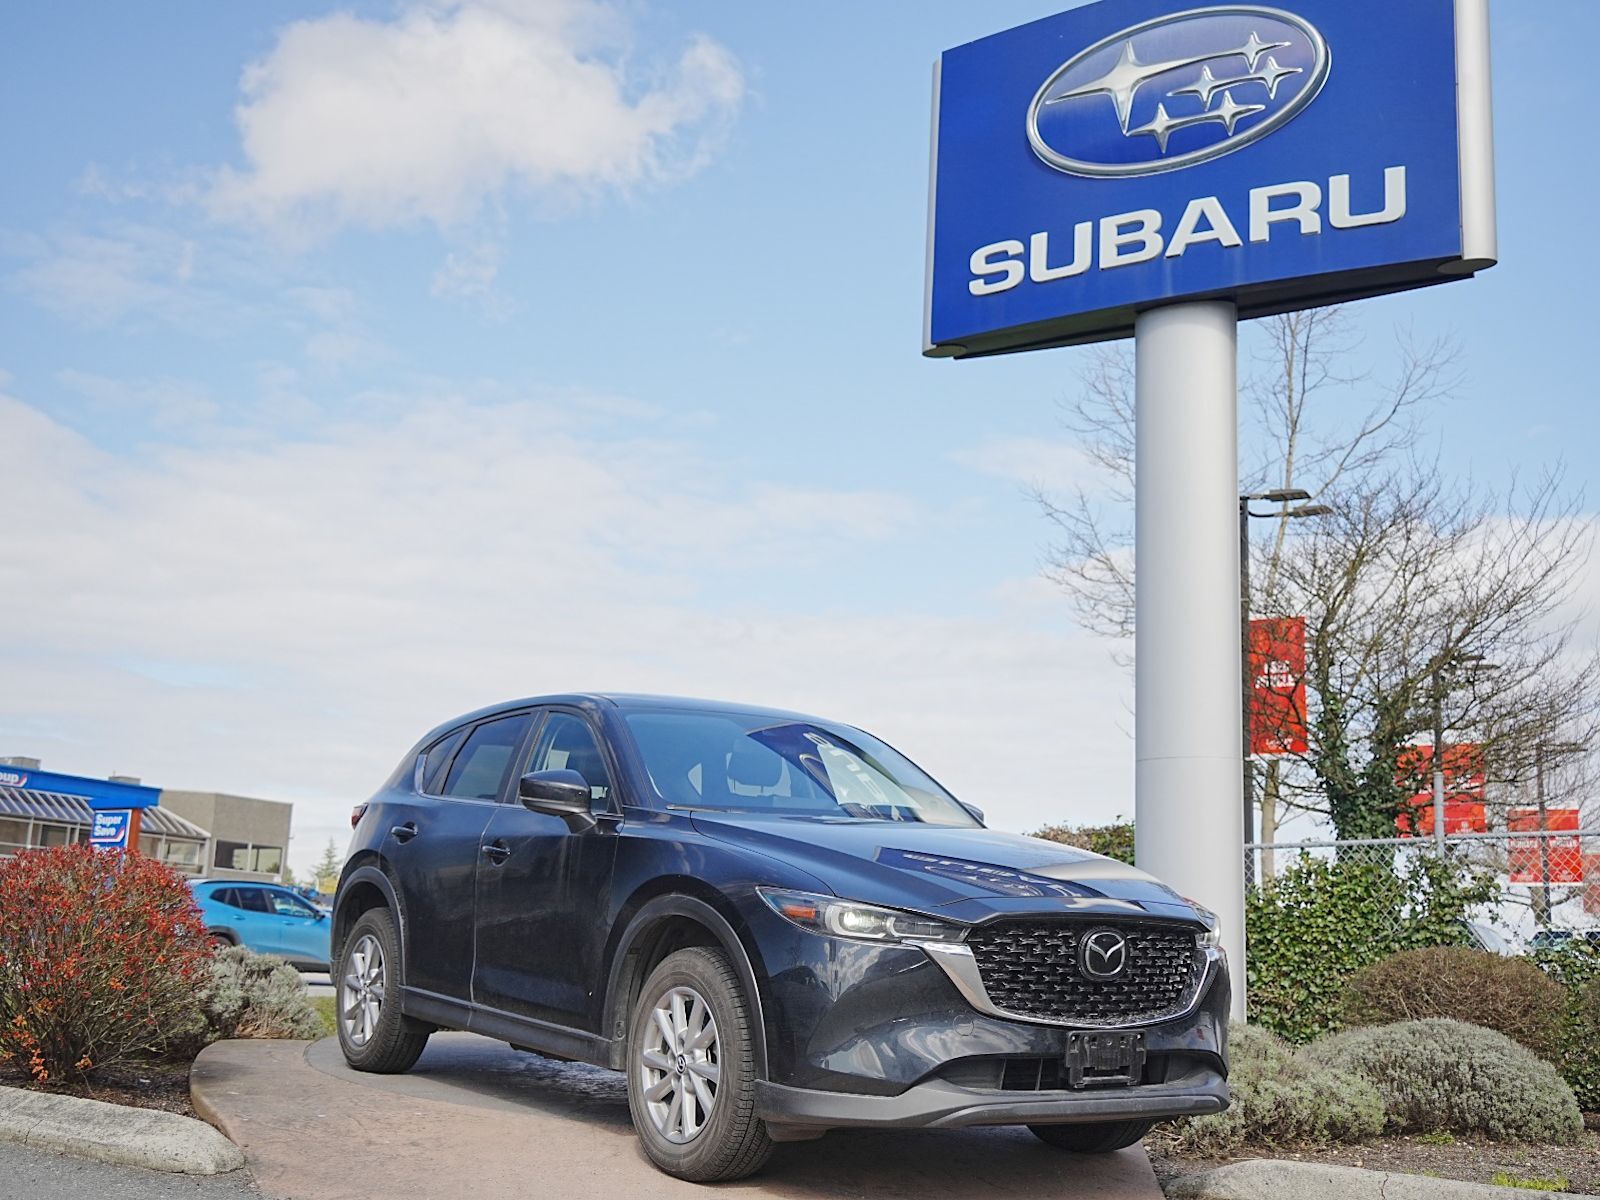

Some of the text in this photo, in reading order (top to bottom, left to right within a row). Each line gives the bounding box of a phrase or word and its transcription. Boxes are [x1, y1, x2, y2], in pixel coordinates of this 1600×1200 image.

[968, 165, 1407, 296] SUBARU
[95, 814, 122, 826] Super
[94, 825, 116, 836] Save
